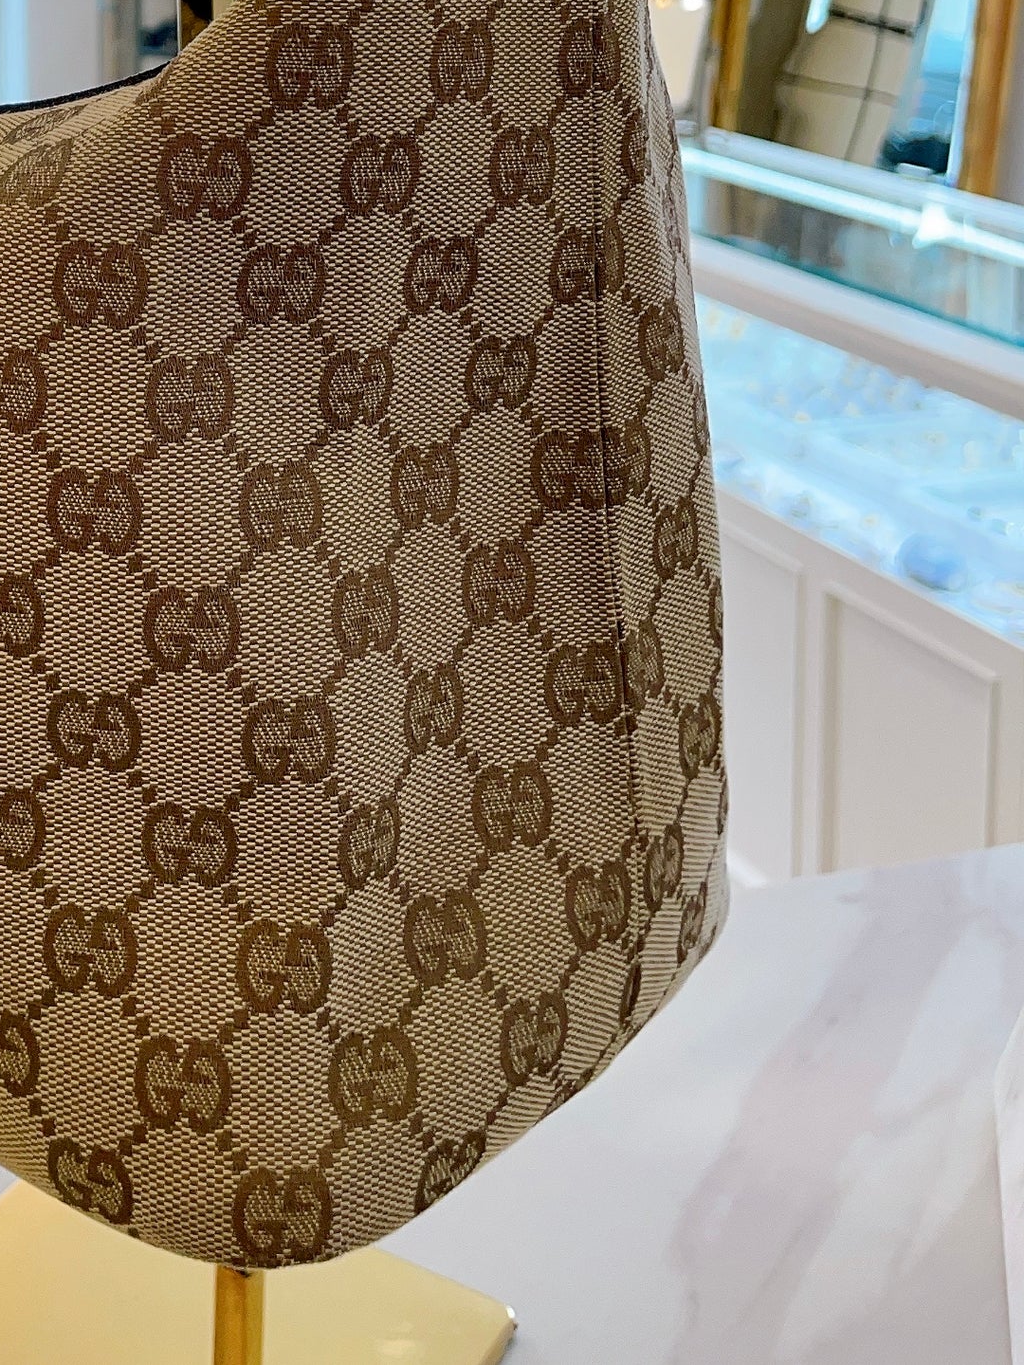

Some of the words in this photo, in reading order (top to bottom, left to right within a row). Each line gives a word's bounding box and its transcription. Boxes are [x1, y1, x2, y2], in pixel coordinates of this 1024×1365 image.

[268, 25, 352, 110] GG
[430, 20, 495, 105] GG
[158, 134, 252, 220] GG
[344, 134, 420, 214] GG
[487, 127, 556, 208] GG
[53, 240, 148, 328] GG
[237, 243, 324, 324] GG
[404, 237, 479, 316] GG
[146, 355, 234, 438] GG
[322, 348, 392, 425] GG
[464, 337, 538, 414] GG
[47, 468, 141, 553] GG
[241, 459, 322, 548] GG
[390, 445, 460, 532] GG
[333, 568, 400, 660] GG
[463, 540, 537, 627] GG
[144, 587, 238, 672] GG
[48, 687, 140, 772] GG
[245, 696, 337, 781] GG
[404, 662, 466, 748] GG
[145, 801, 237, 884] GG
[476, 761, 551, 851] GG
[45, 908, 137, 995] GG
[241, 921, 331, 1012] GG
[406, 893, 486, 982] GG
[134, 1035, 232, 1133] GG
[327, 1025, 419, 1129] GG
